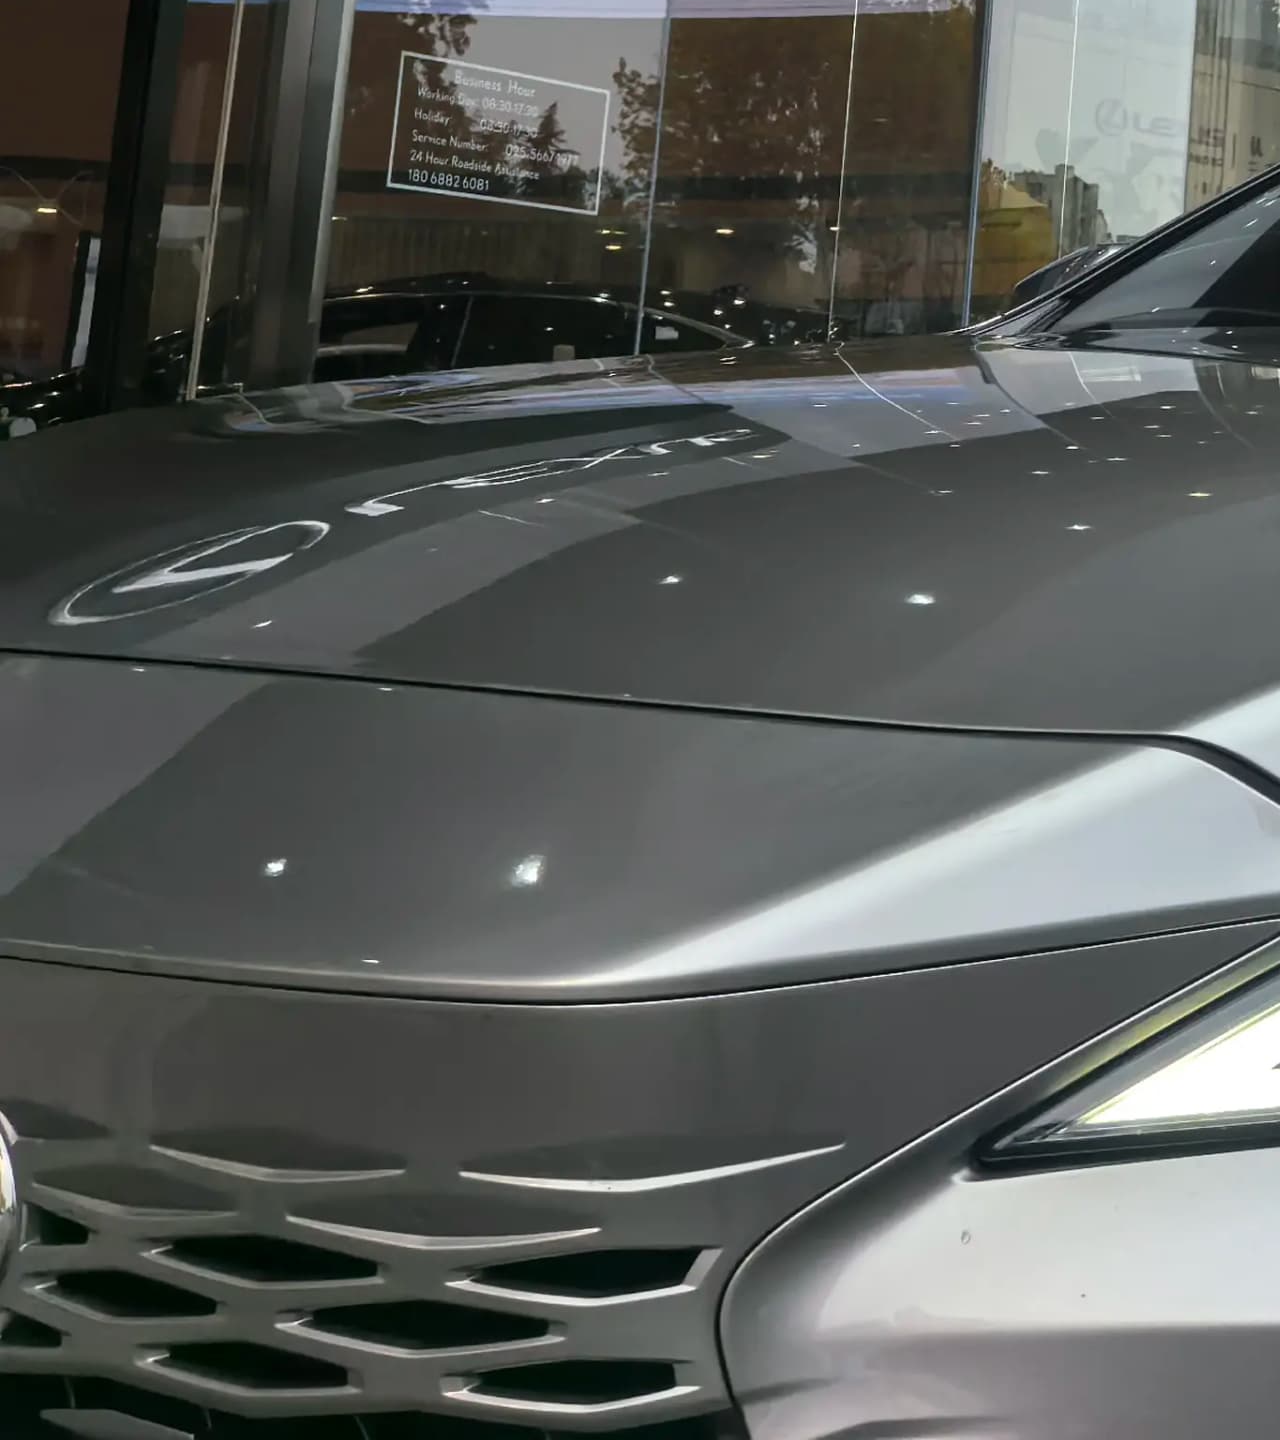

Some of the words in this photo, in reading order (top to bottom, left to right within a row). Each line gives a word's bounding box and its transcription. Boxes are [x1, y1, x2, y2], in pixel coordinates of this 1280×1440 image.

[454, 69, 501, 92] Business
[417, 87, 455, 106] Working
[412, 128, 448, 146] Service
[409, 149, 424, 162] 24
[425, 152, 449, 165] Hour
[451, 155, 492, 173] Roadside
[408, 168, 429, 184] 180
[430, 171, 461, 188] 6882
[462, 177, 490, 192] 6081
